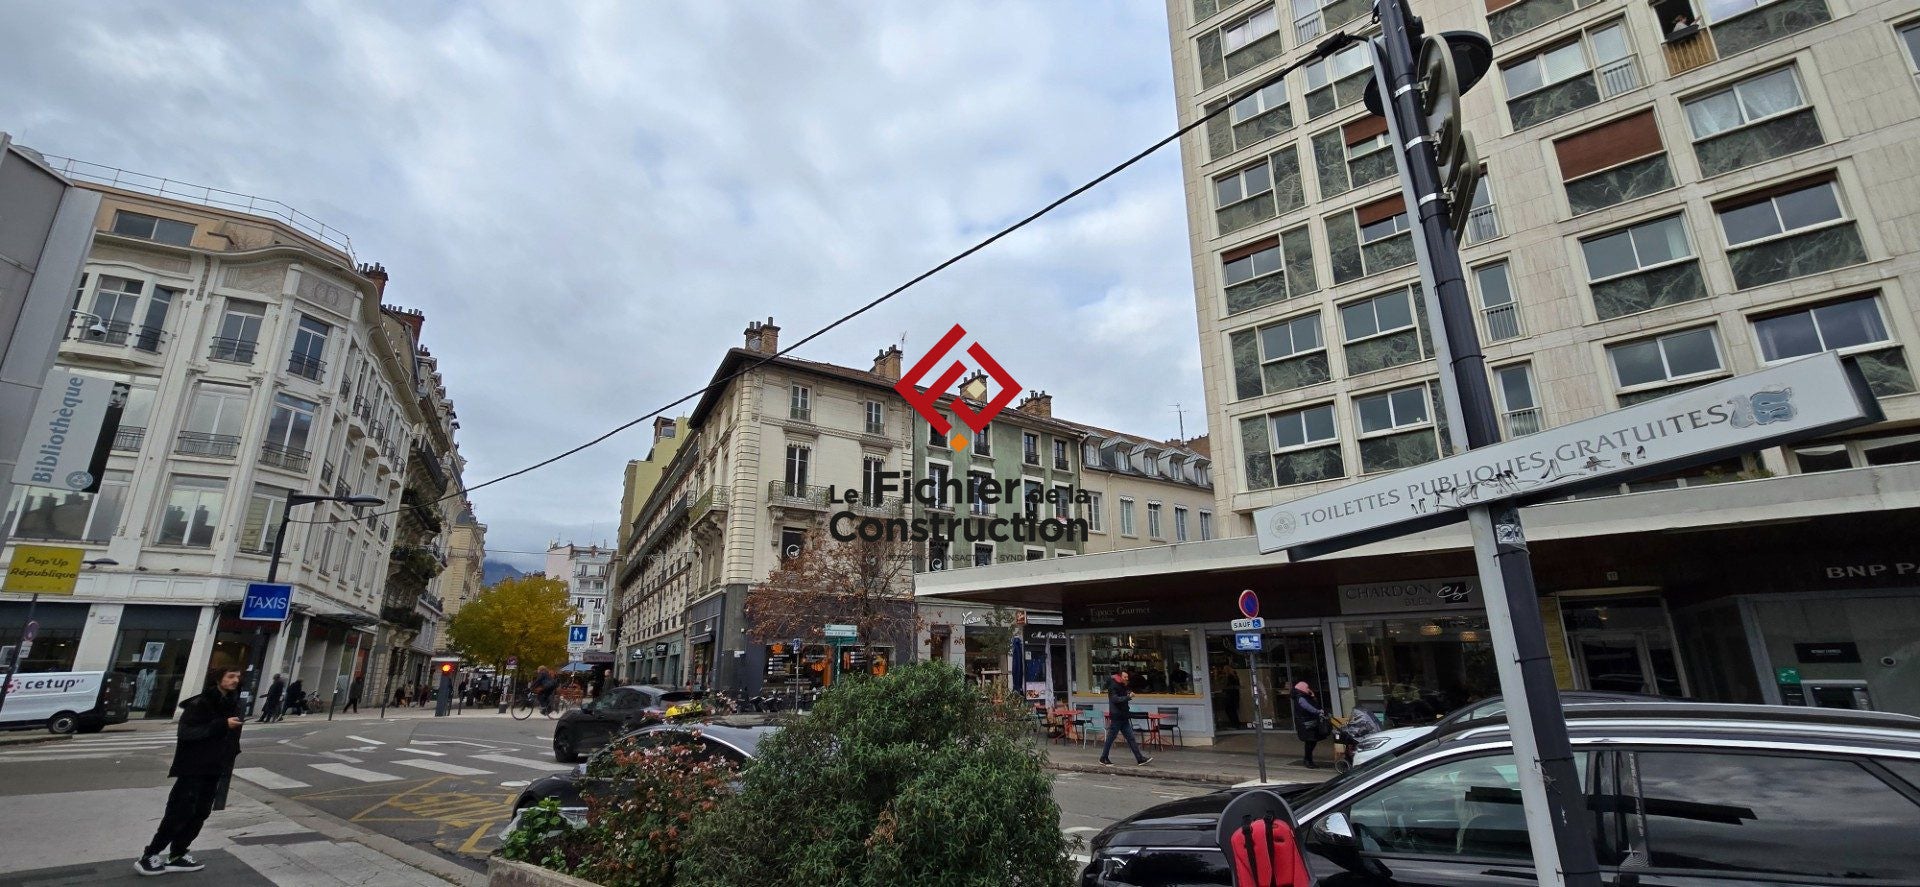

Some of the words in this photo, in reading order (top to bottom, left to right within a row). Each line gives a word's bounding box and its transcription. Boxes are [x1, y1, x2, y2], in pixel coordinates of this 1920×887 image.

[31, 376, 84, 484] Bibliothèque
[1301, 489, 1401, 526] TOILETTES
[1407, 450, 1547, 500] PUBLIQUES
[1555, 404, 1729, 462] GRATUITES
[26, 556, 69, 567] Pop'Up
[10, 567, 77, 579] République
[1825, 564, 1887, 579] BNP
[1346, 585, 1432, 600] CHARDON
[248, 595, 287, 610] TAXIS
[1233, 621, 1251, 629] SAUF
